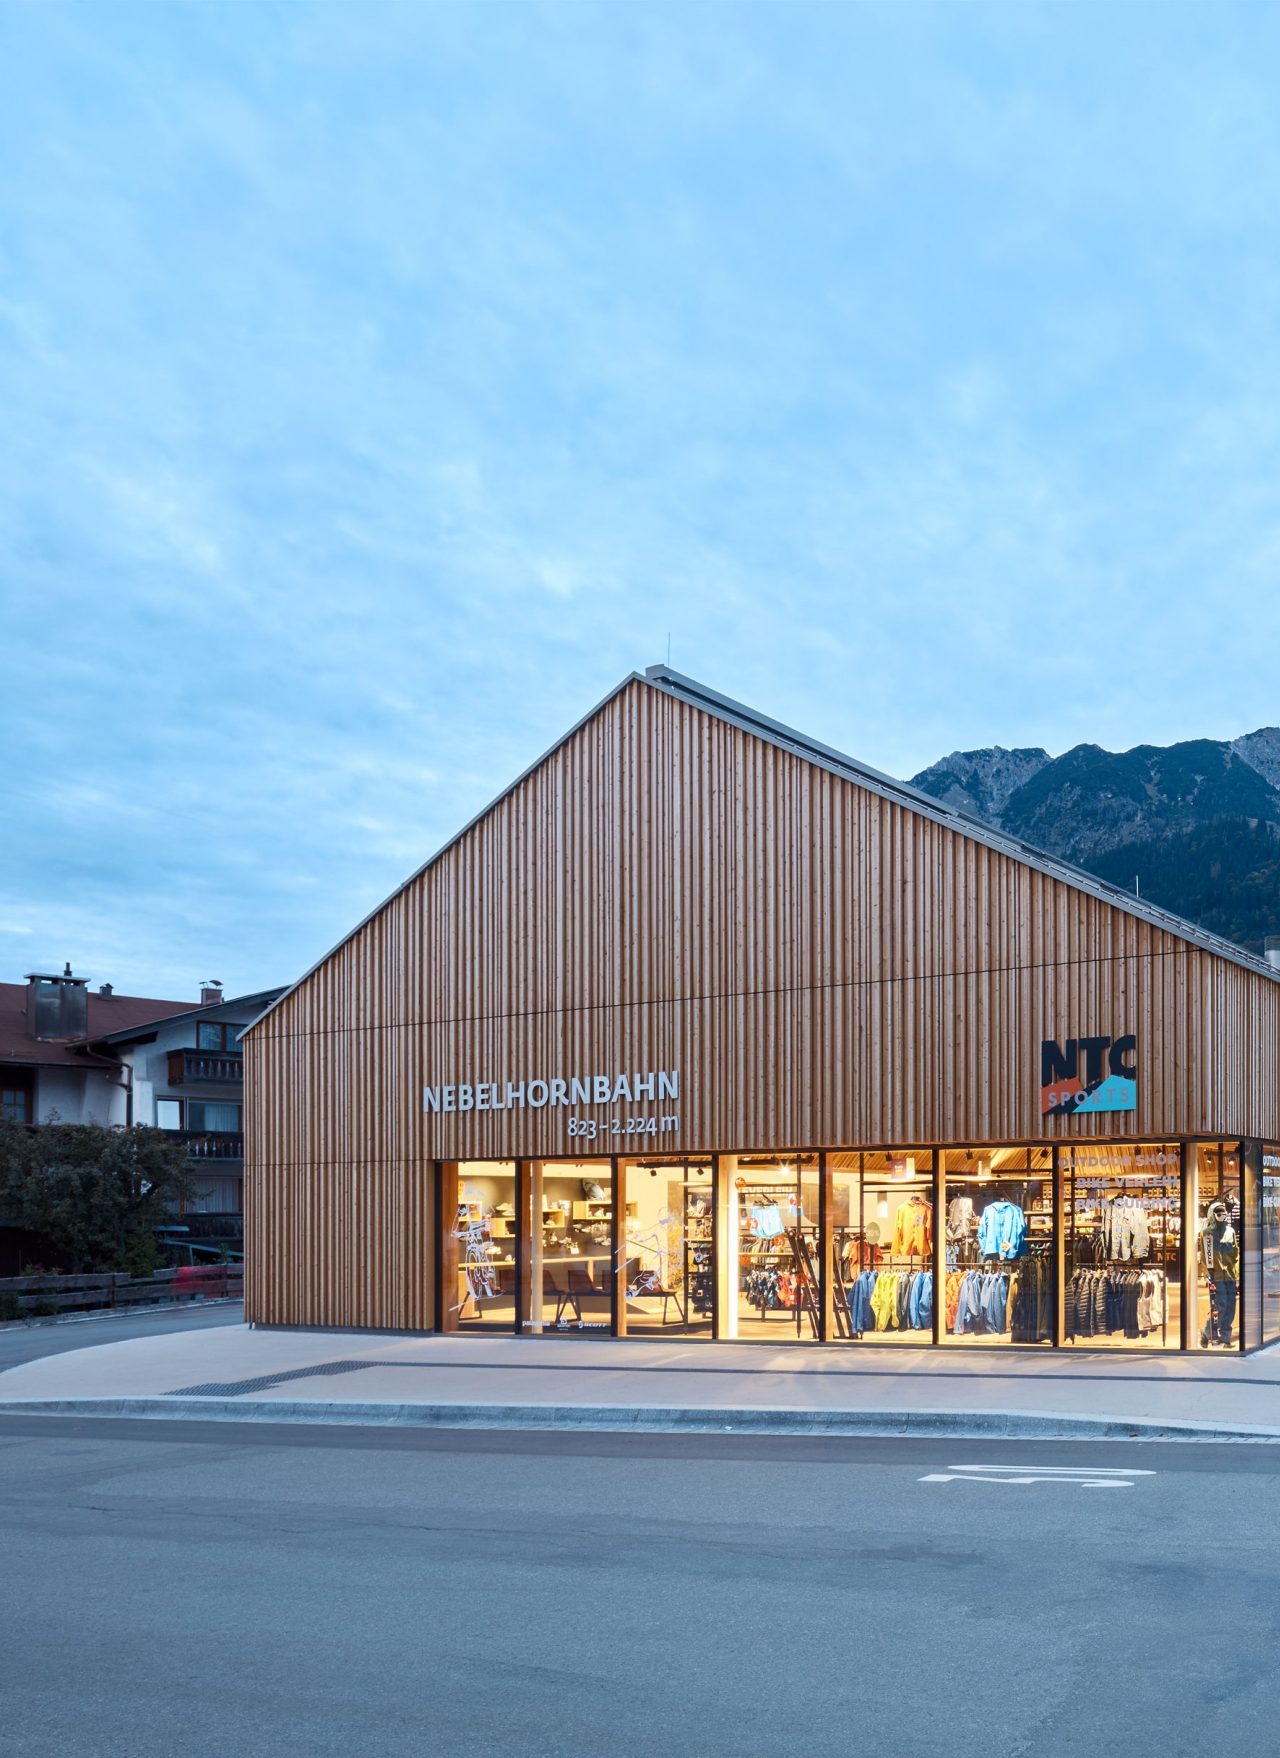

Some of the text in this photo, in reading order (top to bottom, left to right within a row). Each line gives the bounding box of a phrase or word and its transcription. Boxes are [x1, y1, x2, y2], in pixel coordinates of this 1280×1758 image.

[1041, 1035, 1136, 1088] NTC
[423, 1071, 679, 1113] NEBELHORNBAHN
[1047, 1087, 1130, 1108] SPORTS
[567, 1117, 597, 1139] 823
[611, 1117, 657, 1137] 2.224
[661, 1114, 679, 1132] m
[1058, 1153, 1177, 1168] OUTDOOR SHOP
[1076, 1175, 1177, 1188] BIKE VERLEIH
[1076, 1198, 1110, 1209] BIKE
[1157, 1252, 1177, 1261] NTC
